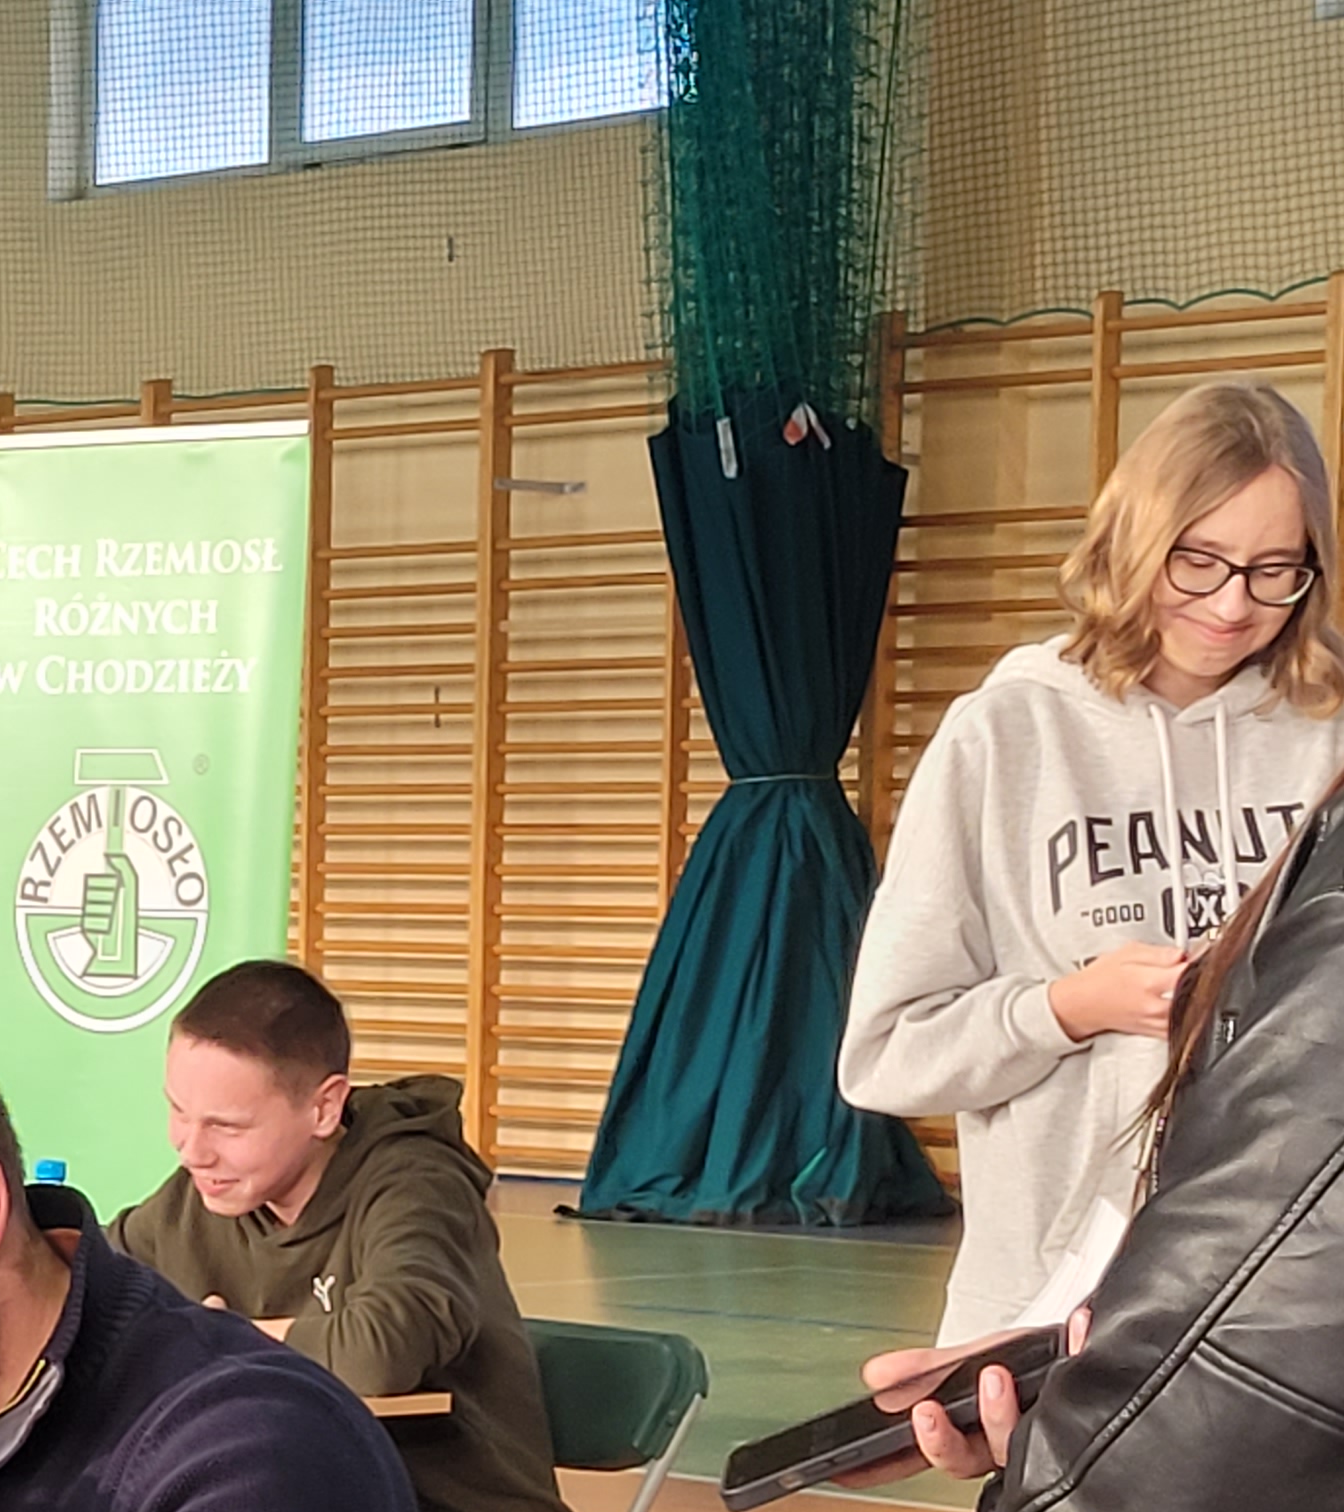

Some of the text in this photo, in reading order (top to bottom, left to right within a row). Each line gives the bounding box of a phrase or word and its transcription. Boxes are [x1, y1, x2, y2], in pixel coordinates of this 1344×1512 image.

[95, 537, 284, 578] RZEMIOSŁ
[32, 592, 219, 637] RÓŻNYCH
[35, 649, 258, 695] CHODZIEŻY
[19, 787, 206, 908] RZEMIOSŁO
